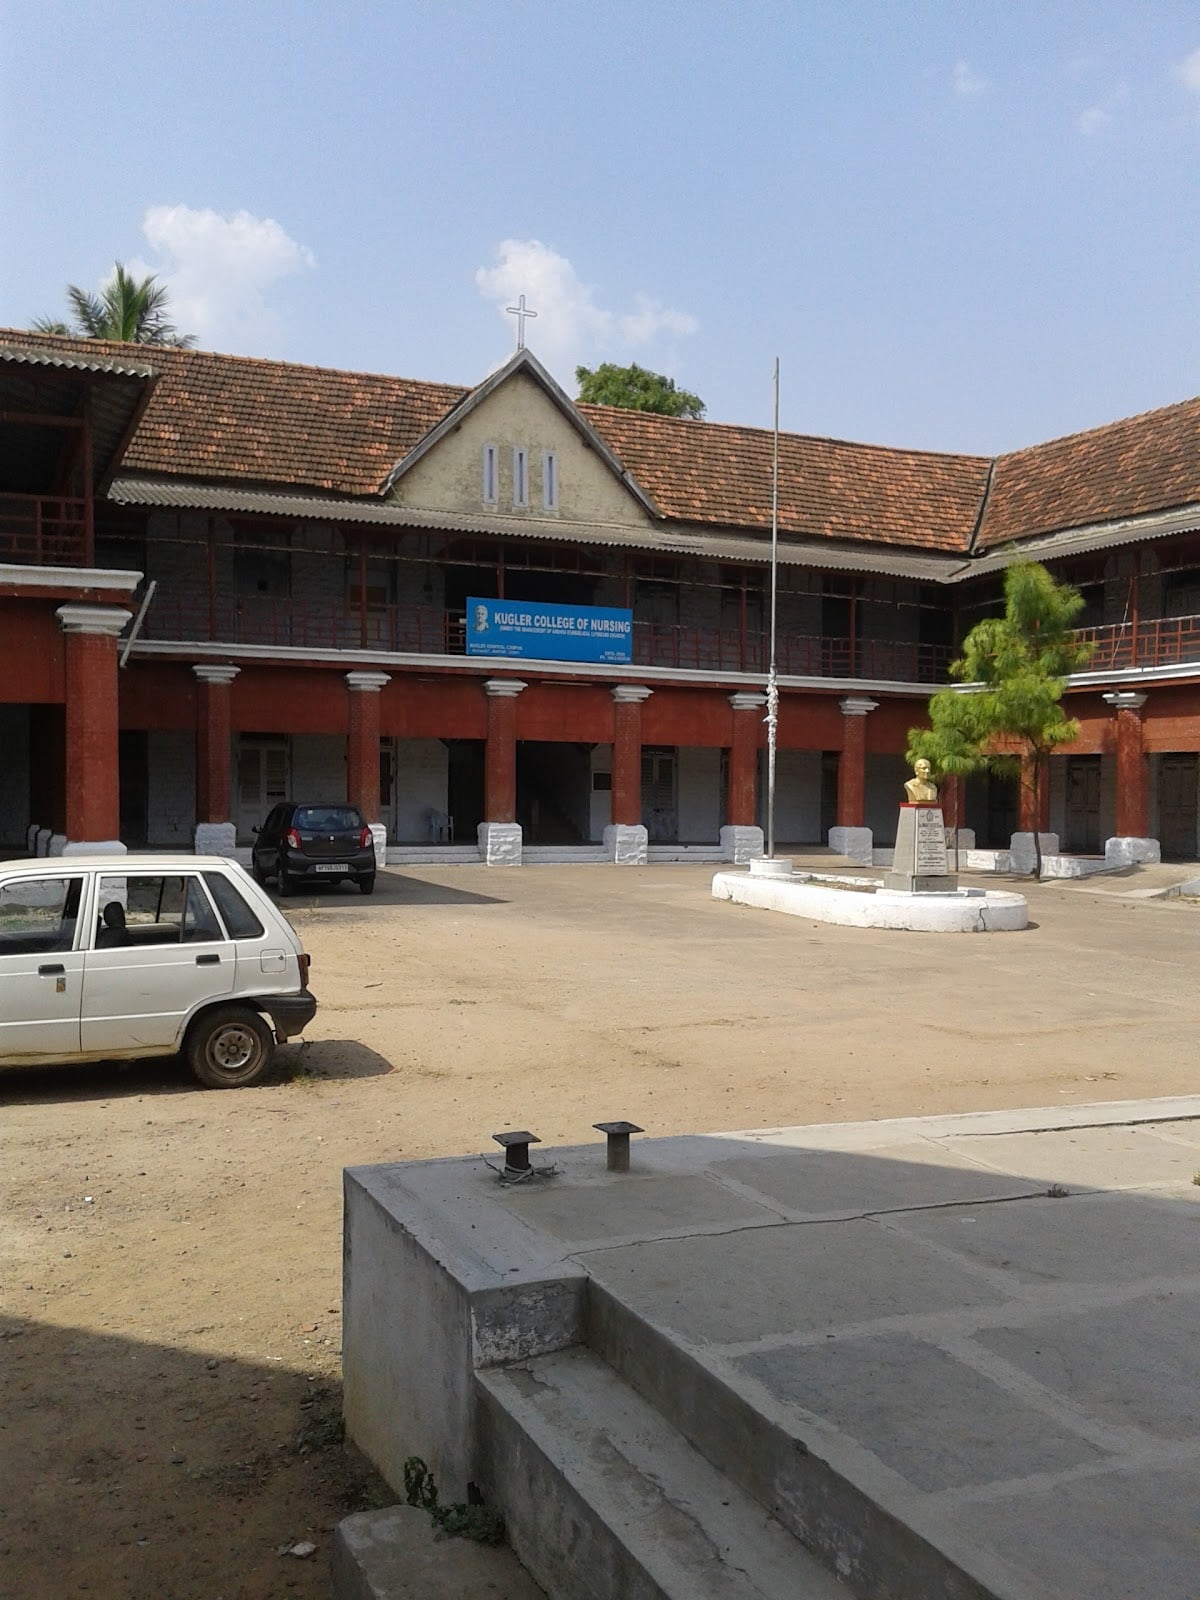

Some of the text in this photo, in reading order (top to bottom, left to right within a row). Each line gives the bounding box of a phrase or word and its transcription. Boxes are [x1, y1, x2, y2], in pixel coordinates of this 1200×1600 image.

[494, 612, 631, 633] KUGLER COLLEGE OF NURSING
